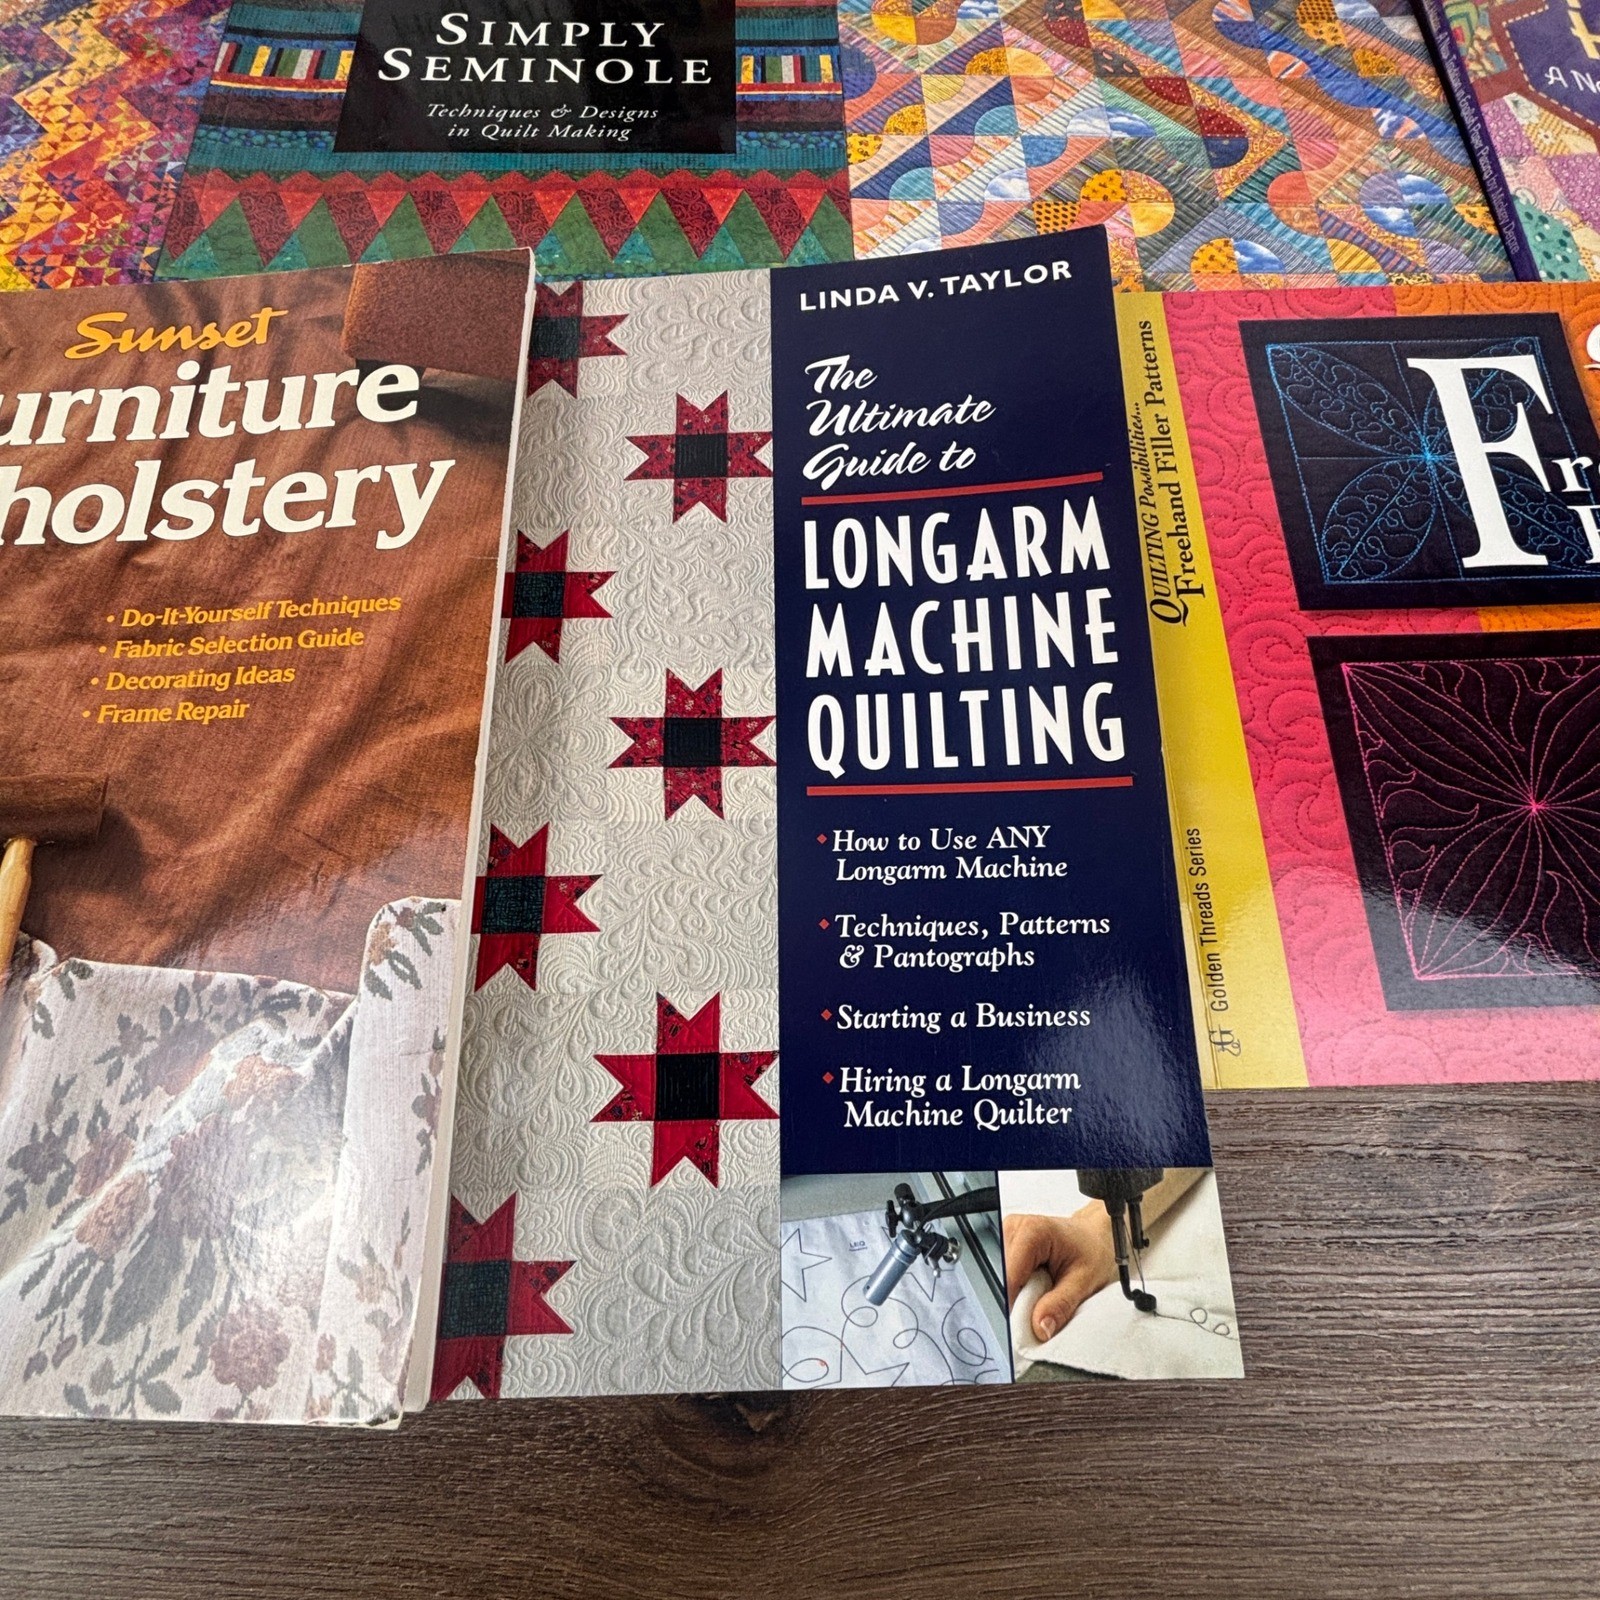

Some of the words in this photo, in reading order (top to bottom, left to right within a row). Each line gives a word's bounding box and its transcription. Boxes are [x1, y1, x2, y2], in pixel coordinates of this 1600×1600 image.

[436, 12, 665, 47] SIMPLY
[378, 47, 712, 84] SEMINOLE
[1544, 66, 1568, 88] A
[1569, 69, 1600, 93] N
[428, 103, 539, 122] Techniques
[550, 104, 570, 119] &
[580, 105, 657, 123] Designs
[447, 123, 471, 137] in
[481, 123, 538, 141] Quilt
[548, 124, 630, 141] Making
[800, 284, 900, 311] LINDA
[907, 280, 934, 300] V.
[939, 260, 1072, 296] TAYLOR
[64, 307, 289, 359] Sunset
[804, 354, 878, 394] The
[1138, 320, 1166, 407] Patterns
[0, 359, 420, 446] urniture
[805, 394, 996, 437] Ultimate
[1130, 402, 1157, 509] Possibilities...
[1150, 413, 1178, 474] Filler
[1406, 354, 1600, 568] Fr
[802, 441, 931, 491] Guide
[938, 440, 977, 472] to
[0, 458, 456, 550] holstery
[804, 495, 1111, 590] LONGARM
[1159, 481, 1206, 599] Freehand
[1142, 513, 1187, 627] QUILTING
[121, 600, 275, 631] Do-It-Yourself
[275, 594, 403, 619] Techniques
[805, 587, 1119, 678] MACHINE
[112, 638, 186, 659] Fabric
[187, 632, 293, 656] Selection
[297, 626, 365, 651] Guide
[104, 668, 232, 692] Decorating
[234, 665, 296, 686] Ideas
[96, 703, 173, 724] Frame
[174, 697, 251, 725] Repair
[807, 681, 1125, 779] QUILTING
[832, 829, 889, 852] How
[898, 833, 921, 851] to
[929, 827, 977, 850] Use
[986, 825, 1051, 849] ANY
[1184, 828, 1207, 877] Series
[836, 858, 947, 886] Longarm
[955, 854, 1068, 879] Machine
[834, 913, 989, 942] Techniques,
[999, 911, 1110, 936] Patterns
[1192, 882, 1218, 947] Threads
[839, 944, 865, 969] &
[874, 942, 1035, 973] Pantographs
[1205, 953, 1226, 1011] Golden
[836, 1004, 942, 1034] Starting
[950, 1011, 967, 1028] a
[976, 1002, 1091, 1028] Business
[839, 1066, 927, 1098] Hiring
[935, 1074, 953, 1092] a
[961, 1065, 1082, 1097] Longarm
[843, 1099, 963, 1128] Machine
[973, 1097, 1073, 1132] Quilter
